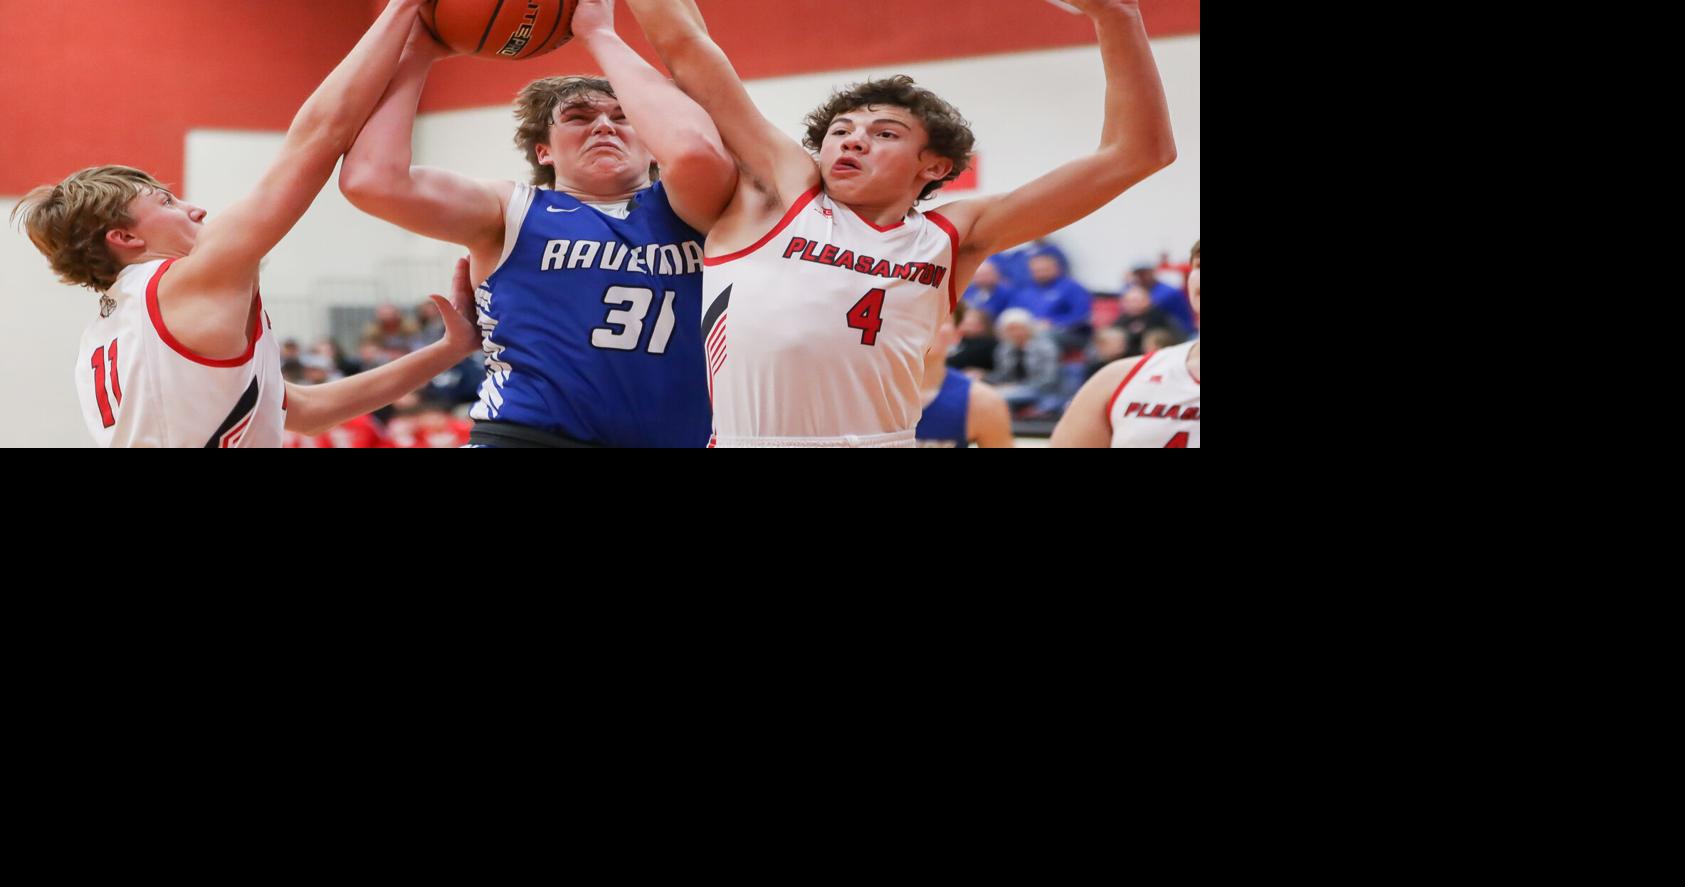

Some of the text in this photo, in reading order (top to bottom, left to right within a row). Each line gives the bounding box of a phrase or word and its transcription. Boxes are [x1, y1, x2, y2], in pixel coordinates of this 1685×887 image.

[514, 0, 540, 38] ITE
[782, 236, 947, 289] PLEASANTON
[588, 284, 677, 355] 31
[846, 287, 886, 347] 4
[91, 337, 122, 429] 11
